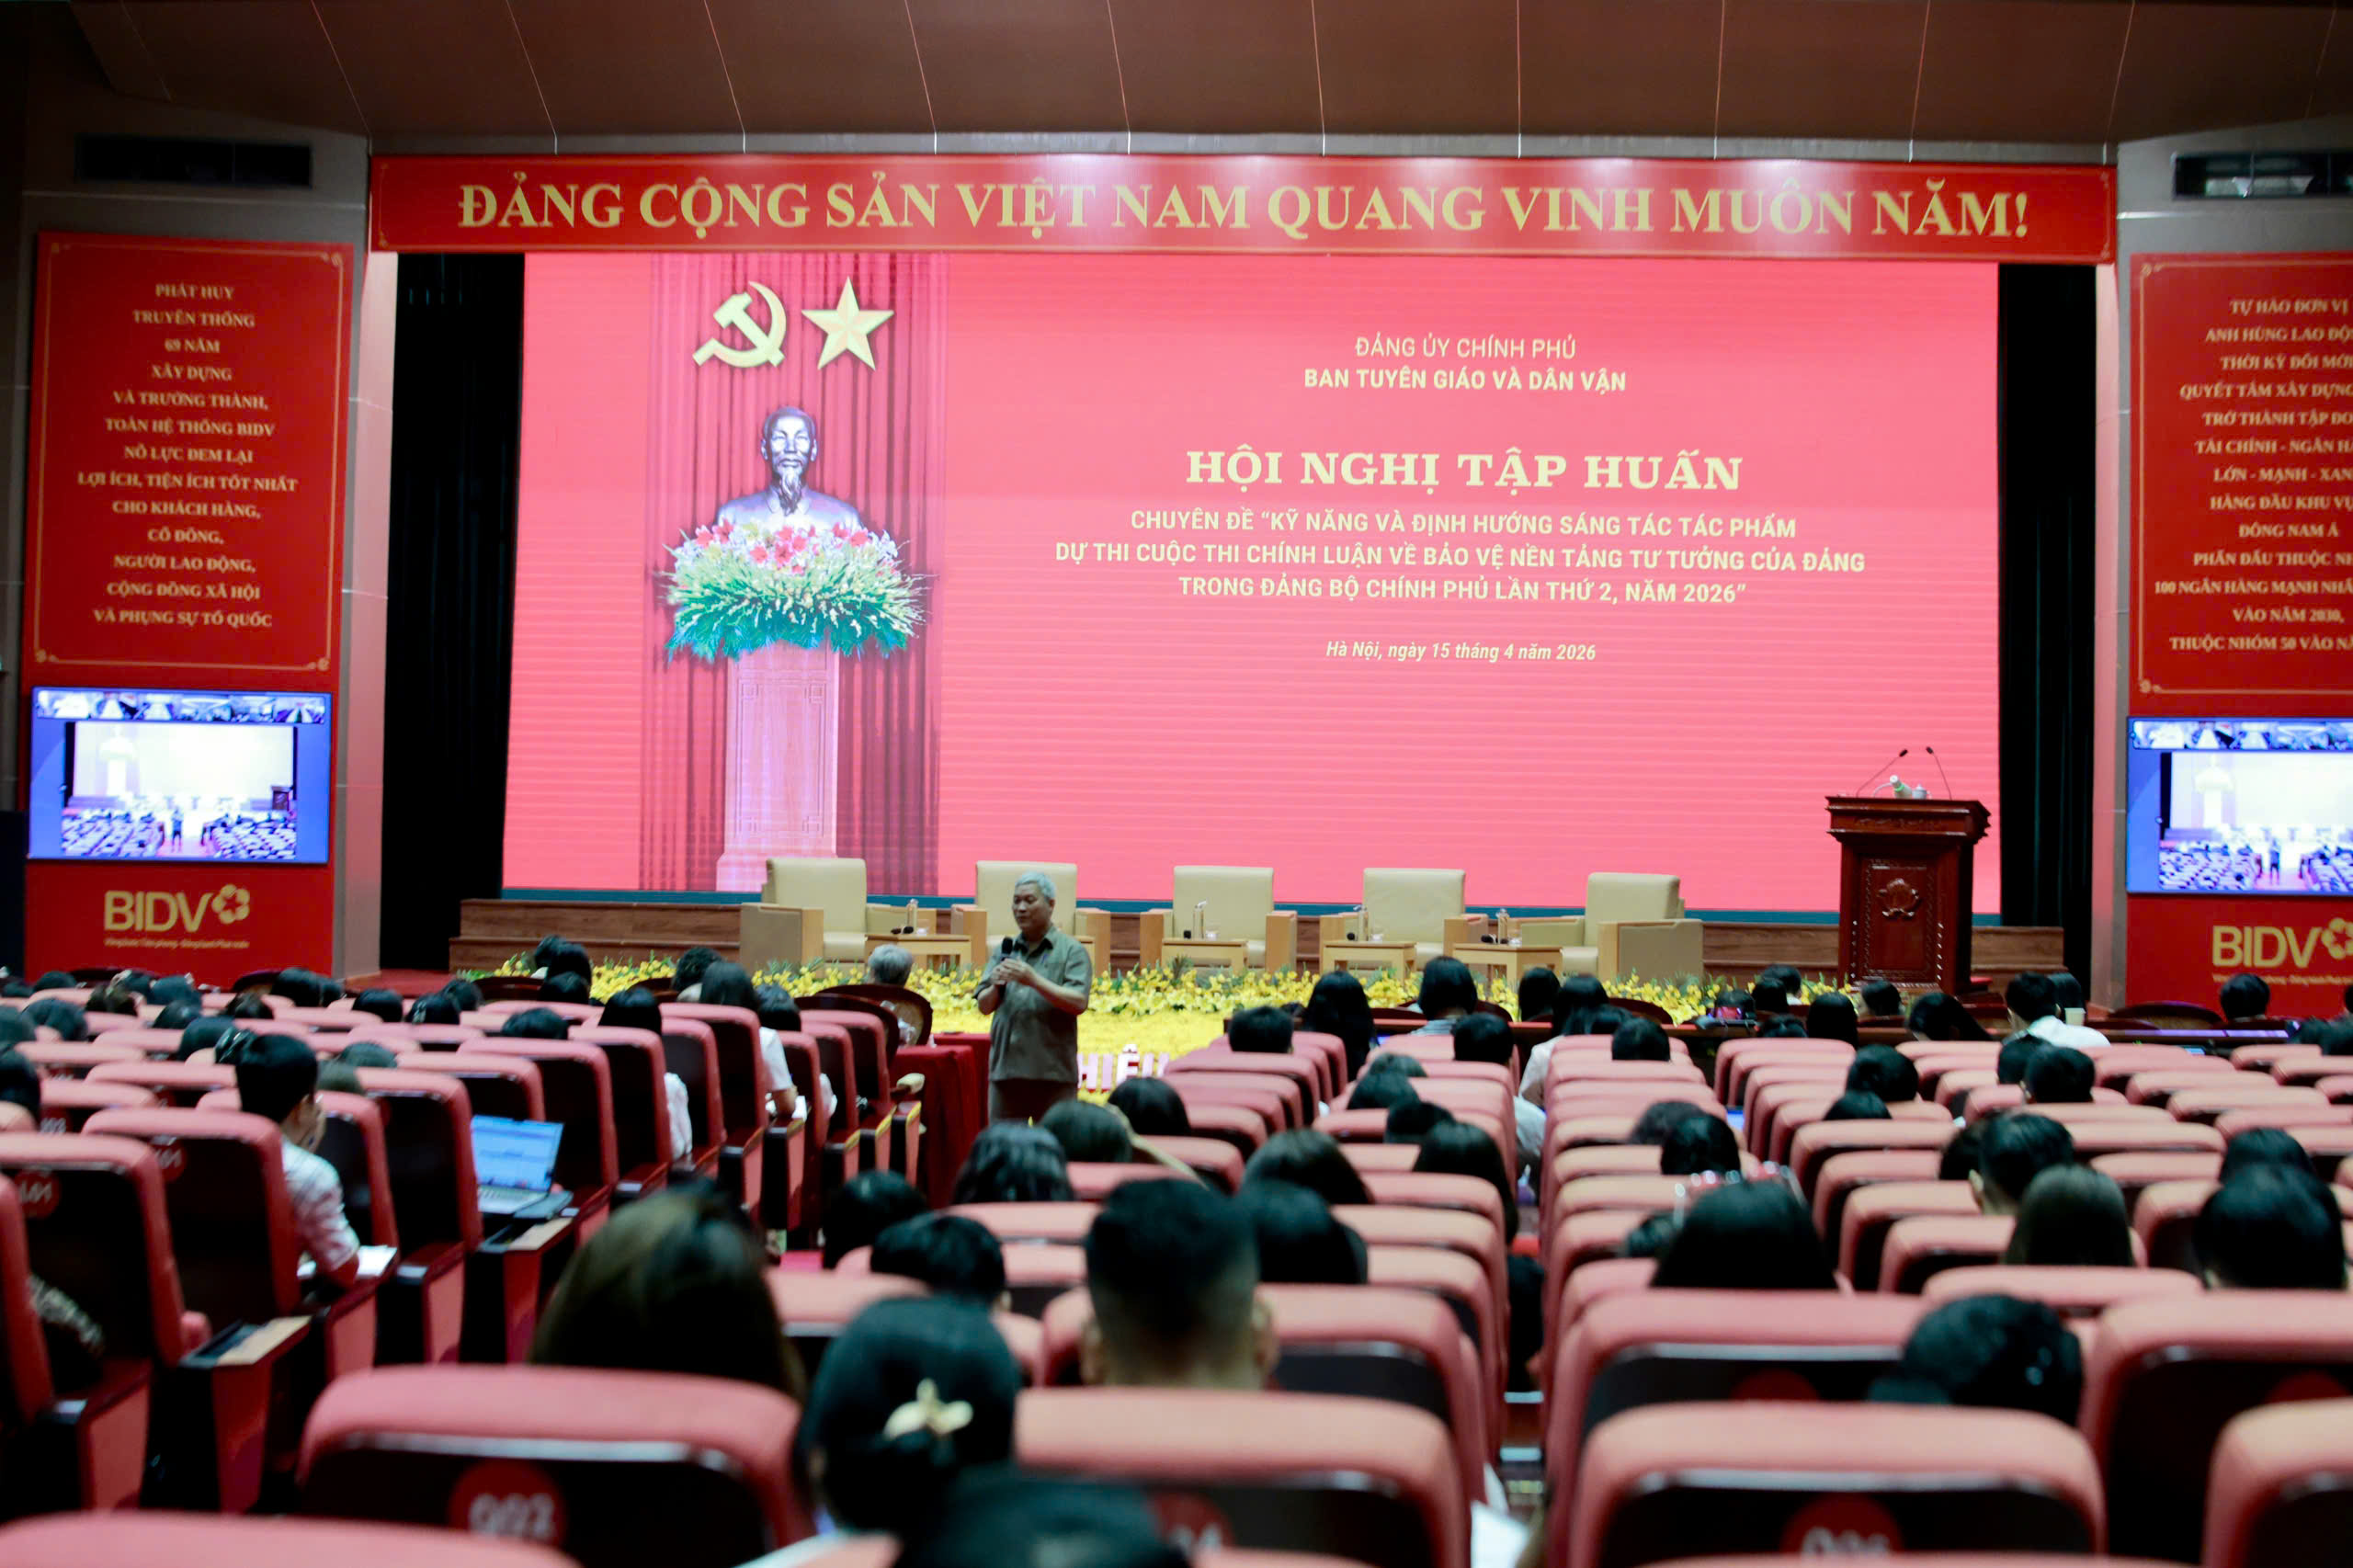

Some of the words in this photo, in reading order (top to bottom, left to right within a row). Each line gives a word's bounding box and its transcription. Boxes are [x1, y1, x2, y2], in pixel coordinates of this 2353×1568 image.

[460, 173, 623, 228] ĐẢNG
[640, 177, 810, 239] CỘNG
[827, 171, 939, 228] SẢN
[956, 174, 1098, 239] VIỆT
[1108, 180, 1252, 228] NAM
[1264, 182, 1485, 239] QUANG
[1502, 183, 1654, 232] VINH
[1671, 176, 1853, 240] MUÔN
[1871, 179, 2027, 237] NĂM!
[156, 284, 197, 298] PHÁT
[201, 287, 233, 300] HUY
[2206, 328, 2238, 342] ANH
[2291, 327, 2325, 341] LAO
[1355, 333, 1415, 357] ĐẢNG
[1423, 333, 1449, 358] ỦY
[1457, 335, 1524, 358] CHÍNH
[1532, 335, 1575, 358] PHỦ
[188, 367, 232, 382] DỰNG
[1305, 369, 1348, 387] BAN
[1357, 366, 1427, 388] TUYÊN
[1434, 367, 1485, 390] GIÁO
[1493, 367, 1522, 390] VÀ
[1529, 368, 1574, 390] DÂN
[1581, 368, 1625, 394] VẬN
[2298, 409, 2328, 426] TẬP
[237, 423, 274, 436] BIDV
[188, 449, 222, 461] ĐEM
[226, 449, 253, 465] LẠI
[1187, 444, 1282, 493] HỘI
[1301, 452, 1439, 494] NGHỊ
[1458, 447, 1566, 495] TẬP
[1585, 449, 1743, 489] HUẤN
[2259, 468, 2307, 483] MẠNH
[112, 501, 147, 514] CHO
[2296, 496, 2330, 509] KHU
[1131, 507, 1219, 529] CHUYÊN
[1226, 507, 1254, 529] ĐỀ
[1307, 509, 1368, 531] NĂNG
[1375, 510, 1404, 531] VÀ
[1412, 515, 1465, 536] ĐỊNH
[1473, 511, 1552, 534] HƯỚNG
[1560, 512, 1620, 535] SÁNG
[1628, 513, 1671, 536] TÁC
[1678, 514, 1722, 537] TÁC
[1730, 513, 1795, 537] PHẨM
[2288, 525, 2324, 537] NAM
[170, 557, 203, 570] LAO
[1056, 542, 1088, 564] DỰ
[1093, 543, 1129, 561] THI
[1137, 540, 1196, 566] CUỘC
[1203, 544, 1239, 562] THI
[1247, 541, 1315, 563] CHÍNH
[1324, 542, 1381, 568] LUẬN
[1390, 541, 1416, 564] VỀ
[1424, 542, 1469, 565] BẢO
[1476, 544, 1504, 570] VỆ
[1511, 543, 1554, 566] NỀN
[1562, 544, 1621, 568] TẢNG
[1630, 550, 1662, 568] TƯ
[1666, 545, 1744, 570] TƯỞNG
[1751, 546, 1796, 571] CỦA
[1802, 548, 1864, 572] ĐẢNG
[231, 584, 260, 601] HỘI
[1179, 577, 1254, 596] TRONG
[1260, 573, 1322, 597] ĐẢNG
[1330, 575, 1358, 601] BỘ
[1367, 575, 1436, 598] CHÍNH
[1444, 575, 1488, 599] PHỦ
[1495, 576, 1539, 599] LẦN
[1546, 578, 1595, 600] THỨ
[1599, 583, 1618, 605] 2,
[1626, 579, 1676, 601] NĂM
[2155, 581, 2177, 594] 100
[2272, 581, 2318, 596] MẠNH
[177, 612, 199, 626] SỰ
[1326, 641, 1347, 656] Hà
[1353, 642, 1382, 660] Nội,
[1388, 642, 1427, 662] ngày
[1433, 642, 1450, 658] 15
[1456, 642, 1499, 663] tháng
[1504, 644, 1514, 658] 4
[1518, 643, 1552, 659] năm
[1556, 644, 1596, 660] 2026
[105, 891, 214, 932] BIDV
[2212, 926, 2323, 968] BIDV
